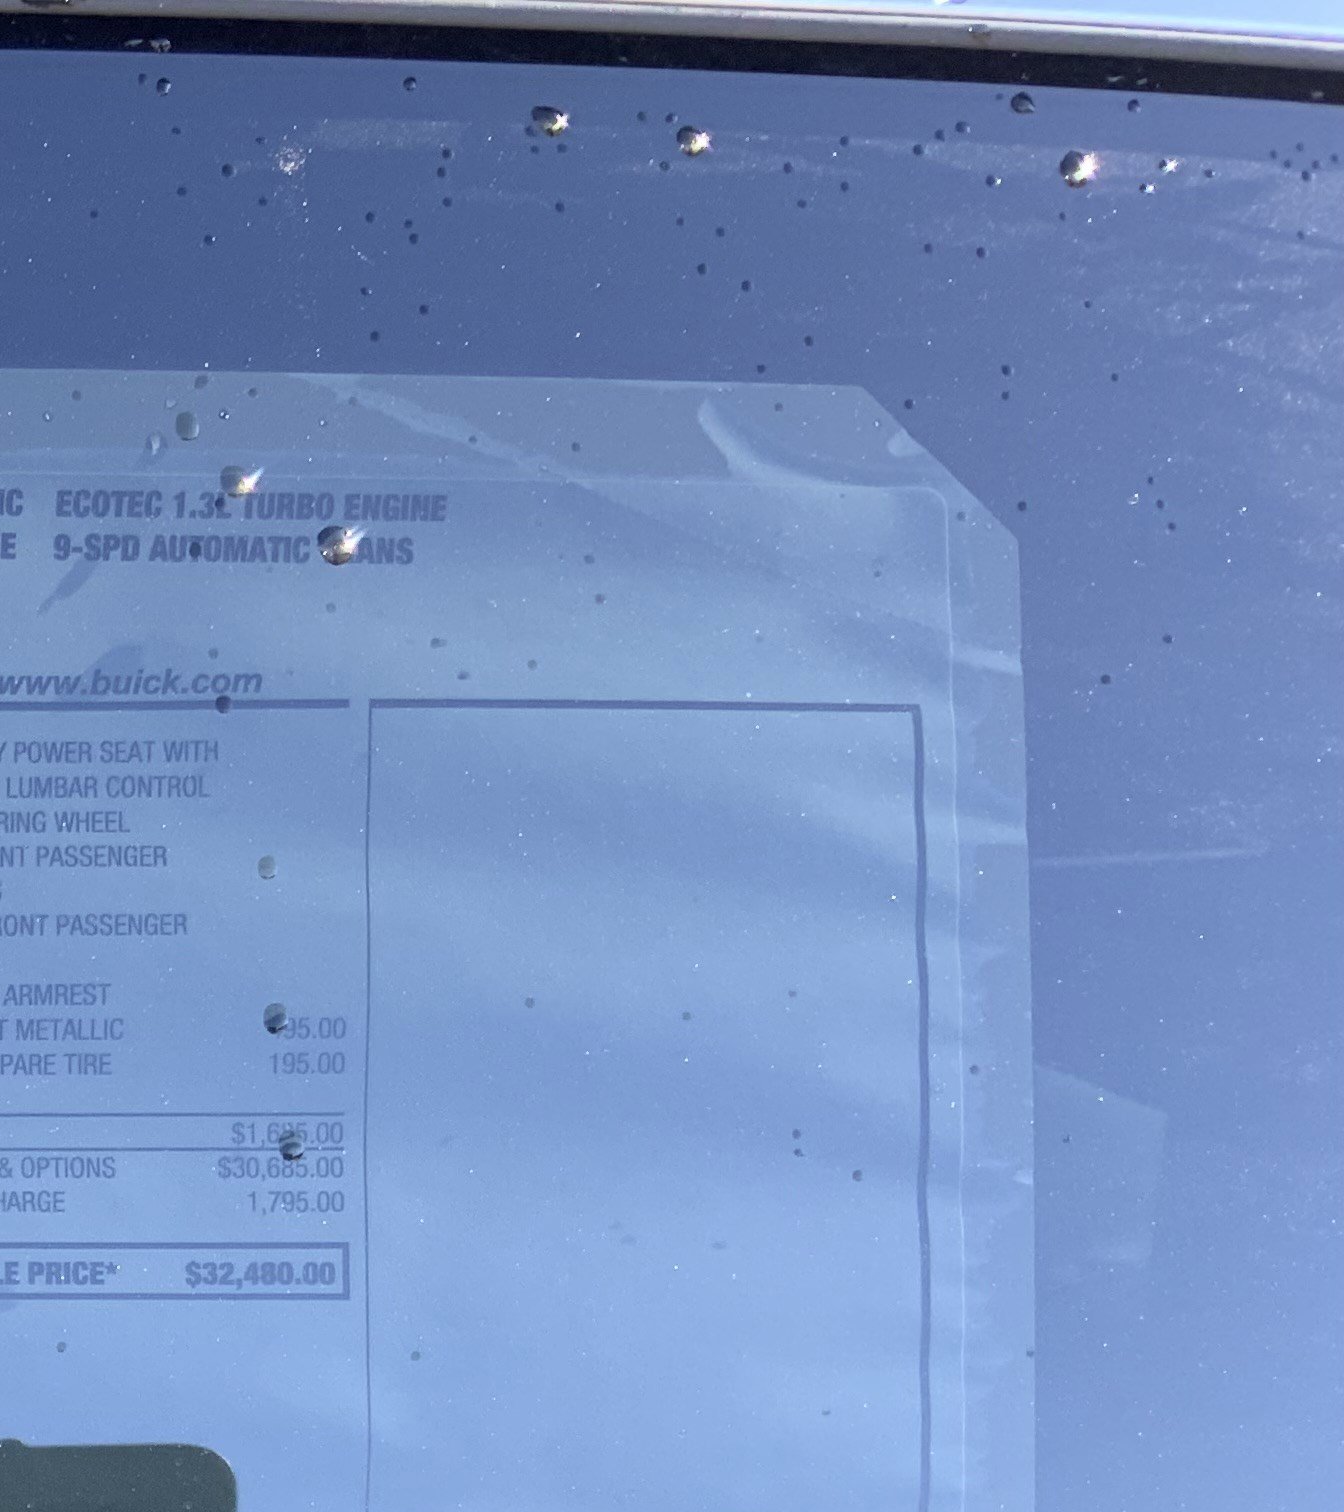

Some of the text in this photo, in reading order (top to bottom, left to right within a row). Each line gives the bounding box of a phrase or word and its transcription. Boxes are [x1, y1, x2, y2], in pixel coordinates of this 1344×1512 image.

[64, 1053, 111, 1075] TIRE
[271, 1052, 345, 1074] 195.00
[185, 1261, 335, 1290] $32,480.00
